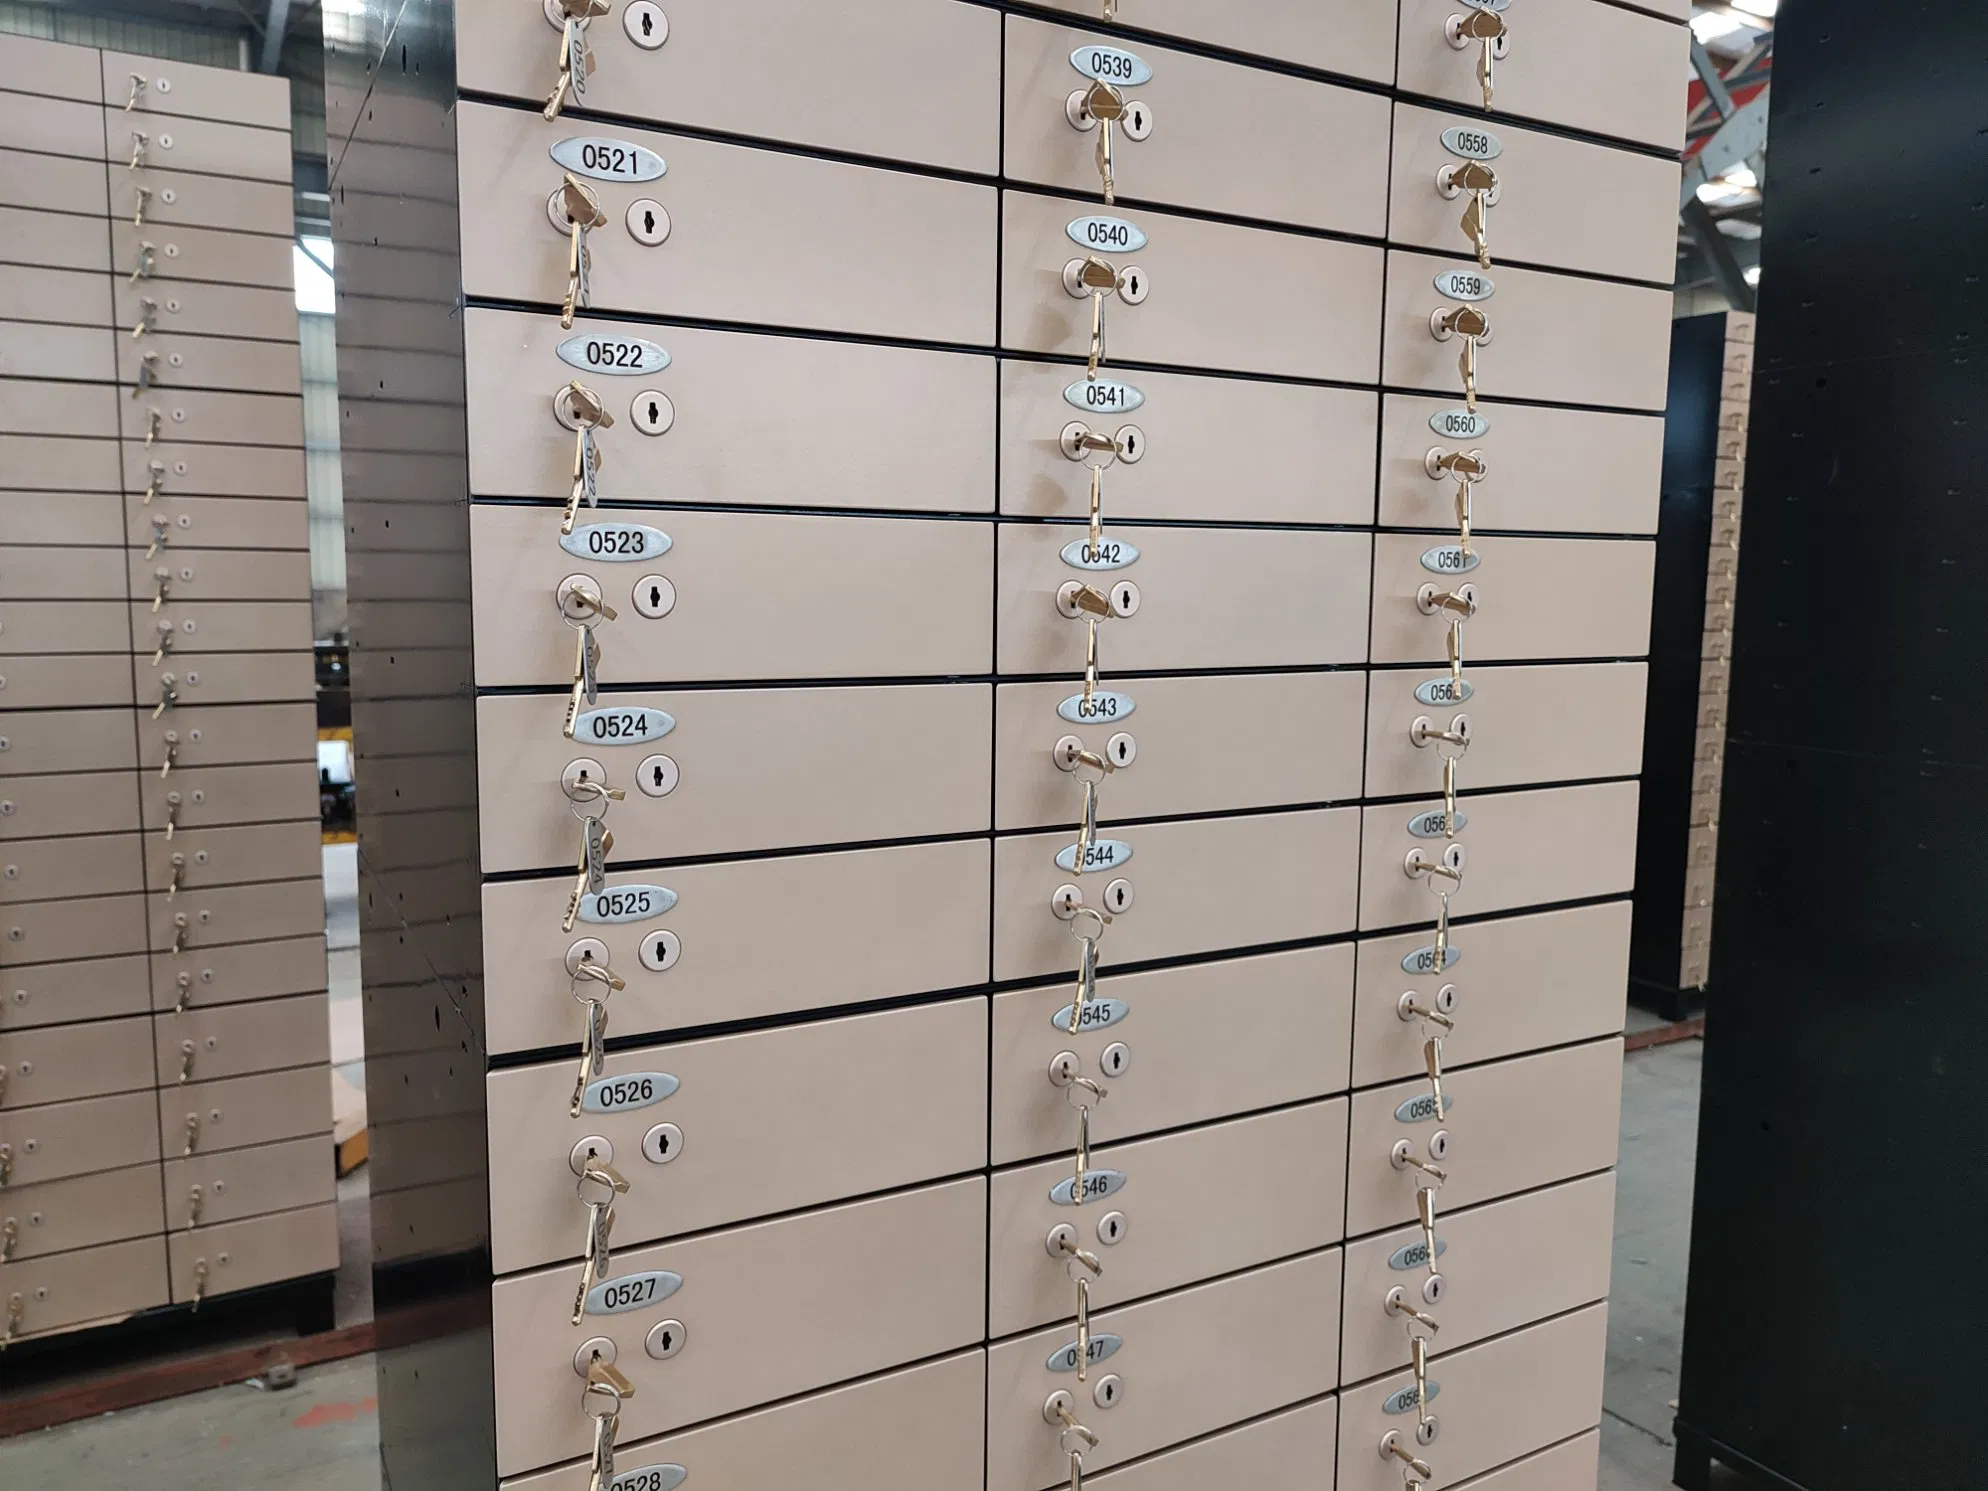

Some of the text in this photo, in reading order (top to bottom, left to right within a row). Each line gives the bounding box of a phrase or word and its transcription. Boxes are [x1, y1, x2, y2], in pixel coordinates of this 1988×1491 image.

[574, 39, 586, 95] 0520
[1091, 51, 1133, 78] 0539
[1457, 131, 1488, 154] 0558
[581, 144, 639, 175] 0521
[1087, 222, 1128, 246] 0540
[1450, 275, 1481, 295] 0559
[586, 341, 644, 369] 0522
[1086, 384, 1125, 407] 0541
[1445, 414, 1476, 433] 0560
[586, 447, 596, 496] 0522
[588, 530, 645, 555] 0523
[1431, 683, 1456, 701] 056
[592, 713, 648, 739] 0524
[1424, 815, 1448, 834] 056
[1079, 844, 1115, 865] 544
[596, 890, 651, 918] 0525
[1077, 1002, 1113, 1026] 545
[600, 1078, 653, 1108] 0526
[1404, 1246, 1428, 1266] 056
[604, 1277, 656, 1309] 0527
[1066, 1340, 1104, 1367] 047
[1398, 1390, 1422, 1410] 056
